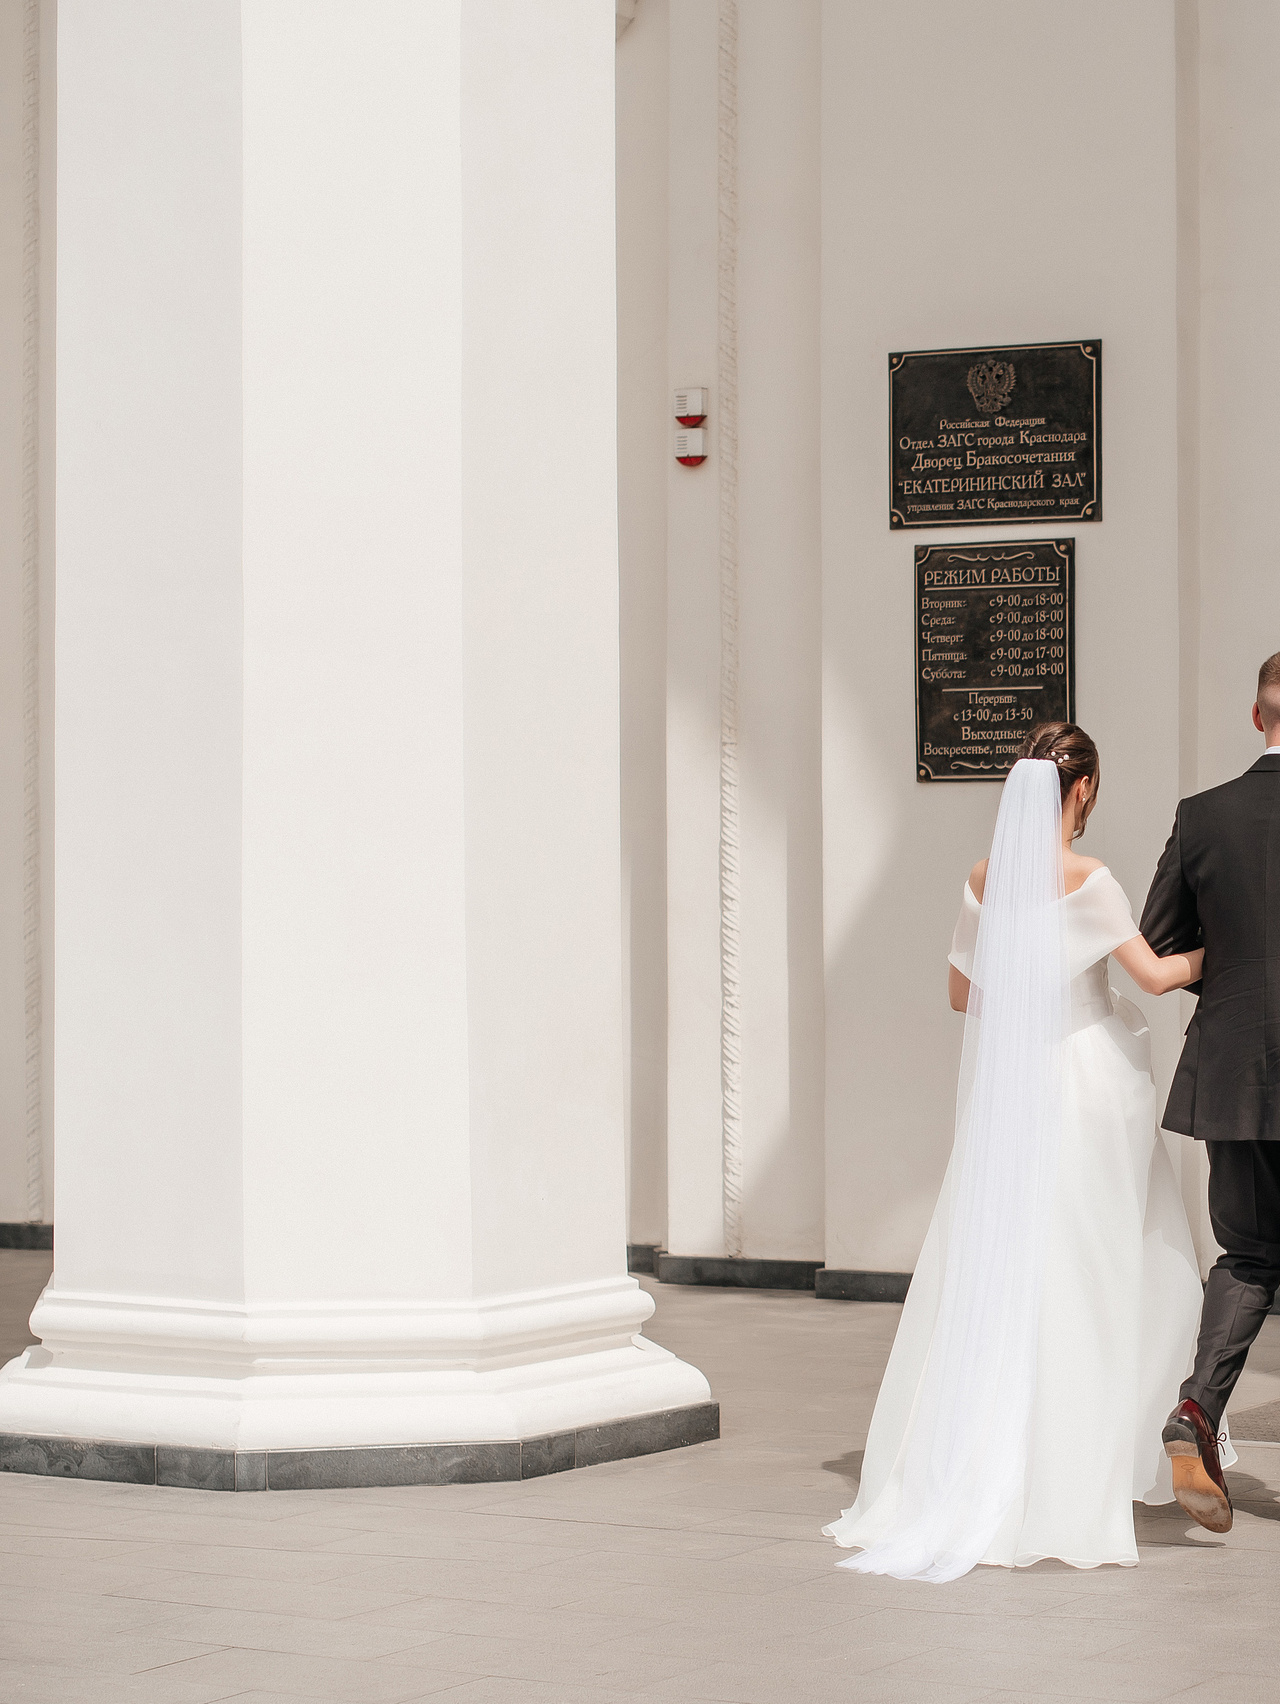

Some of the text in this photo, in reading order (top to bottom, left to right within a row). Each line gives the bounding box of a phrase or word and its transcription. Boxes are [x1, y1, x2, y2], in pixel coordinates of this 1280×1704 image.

[939, 416, 1046, 430] Российская Федерация
[899, 431, 1087, 450] Отдел ЗАГС города Краснодара
[911, 450, 1076, 471] Дворец Бракосочетания
[907, 498, 1080, 513] управления ЗАГС Краснодарского края
[924, 566, 1060, 585] РЕЖИМ РАБОТЫ
[922, 598, 966, 610] Вторник:
[996, 595, 1021, 607] 9-00
[1022, 598, 1034, 607] до
[1035, 593, 1064, 605] 18-00
[922, 614, 955, 627] Среда:
[996, 612, 1021, 624] 9-00
[1022, 615, 1034, 624] до
[1035, 610, 1064, 622] 18-00
[922, 632, 964, 645] Четверг:
[997, 630, 1021, 642] 9-00
[1022, 632, 1034, 642] до
[1035, 628, 1064, 640] 18-00
[922, 650, 967, 662] Пятница:
[997, 648, 1021, 660] 9-00
[1022, 651, 1034, 660] до
[1036, 646, 1064, 659] 17-00
[922, 668, 966, 681] Суббота:
[997, 664, 1021, 677] 9-00
[1022, 667, 1034, 677] до
[1036, 663, 1064, 675] 18-00
[968, 692, 1017, 707] Перерыв:
[961, 709, 990, 721] 13-00
[991, 712, 1003, 722] до
[1005, 708, 1033, 720] 13-50
[962, 727, 1027, 741] Выходные:
[924, 743, 993, 757] Воскресенье,
